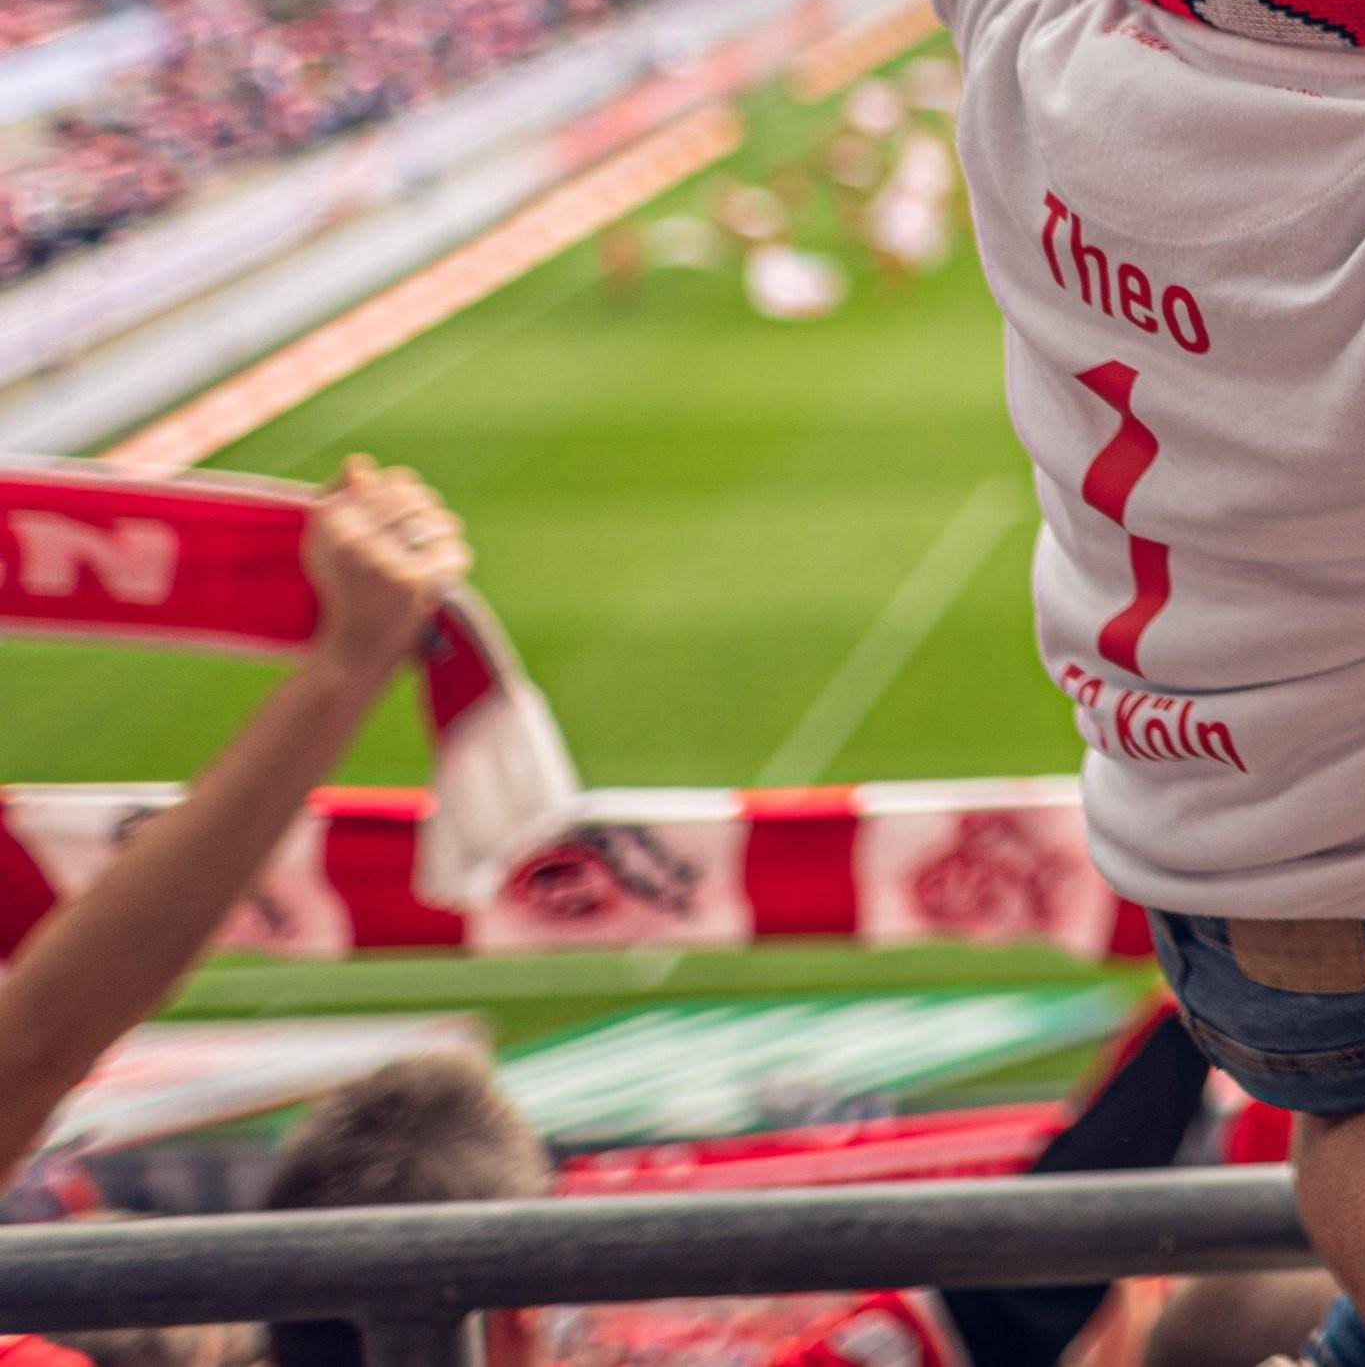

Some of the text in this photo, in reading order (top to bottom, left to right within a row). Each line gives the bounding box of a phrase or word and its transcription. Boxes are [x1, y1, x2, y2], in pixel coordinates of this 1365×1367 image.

[1042, 190, 1210, 355] Theo
[1072, 359, 1171, 679] 1
[1115, 689, 1249, 774] Köln
